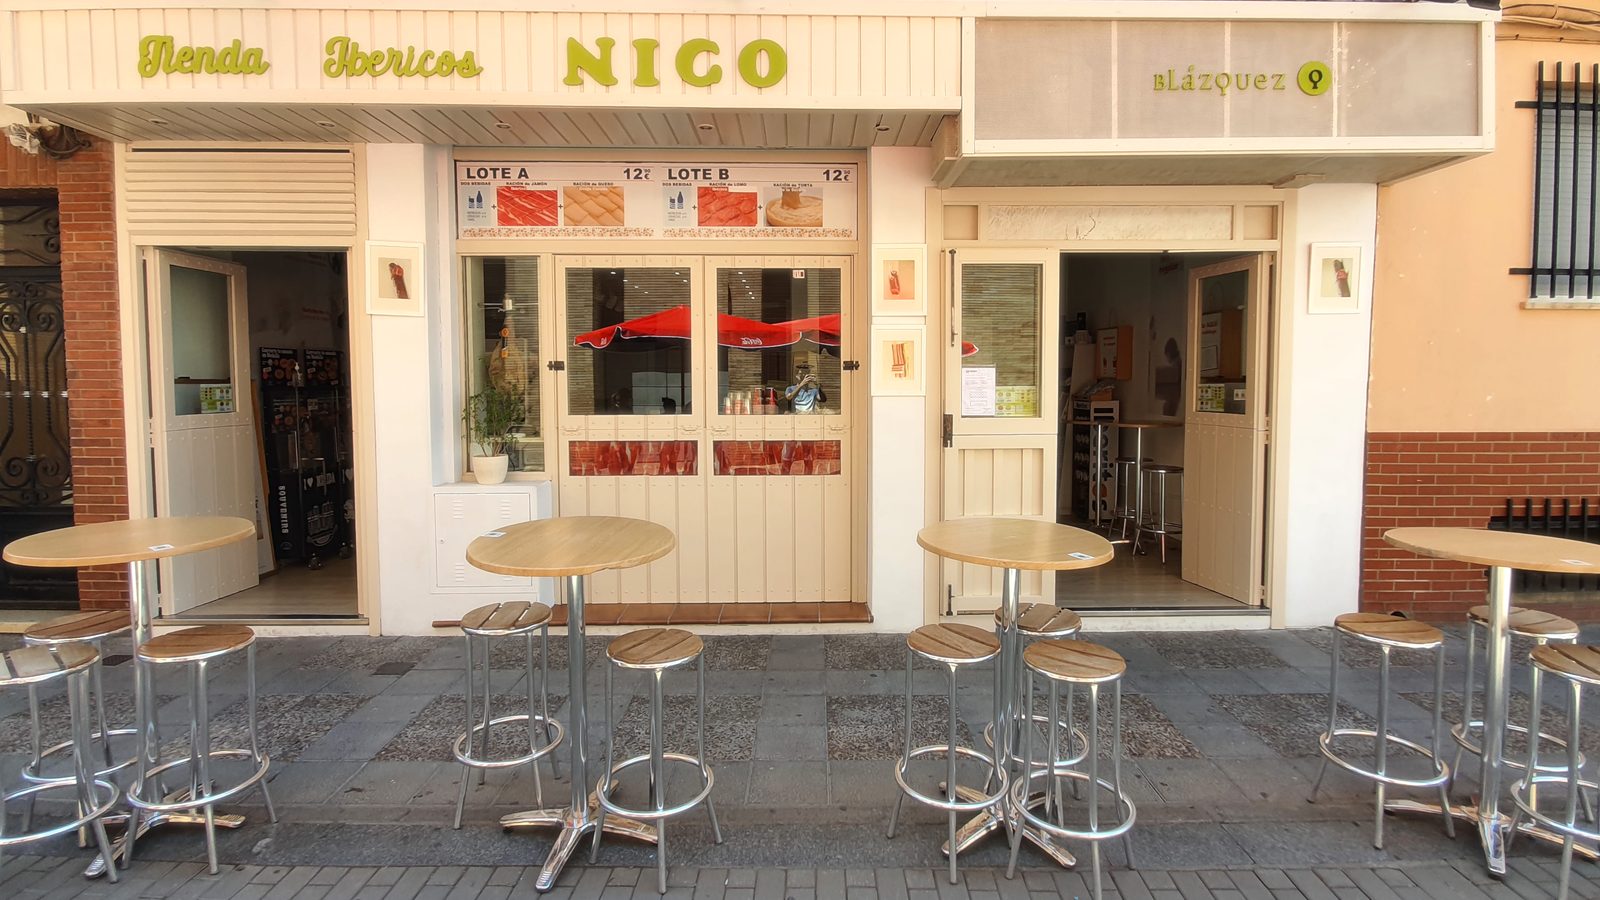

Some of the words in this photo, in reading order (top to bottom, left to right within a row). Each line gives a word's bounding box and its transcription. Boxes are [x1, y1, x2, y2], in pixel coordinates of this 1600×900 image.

[137, 34, 270, 79] Tienda
[323, 35, 484, 79] Ibericos
[562, 36, 788, 89] NICO
[466, 167, 512, 179] LOTE
[517, 167, 530, 179] A
[668, 168, 713, 180] LOTE
[718, 168, 730, 180] B
[278, 485, 289, 534] SOUVENIRS
